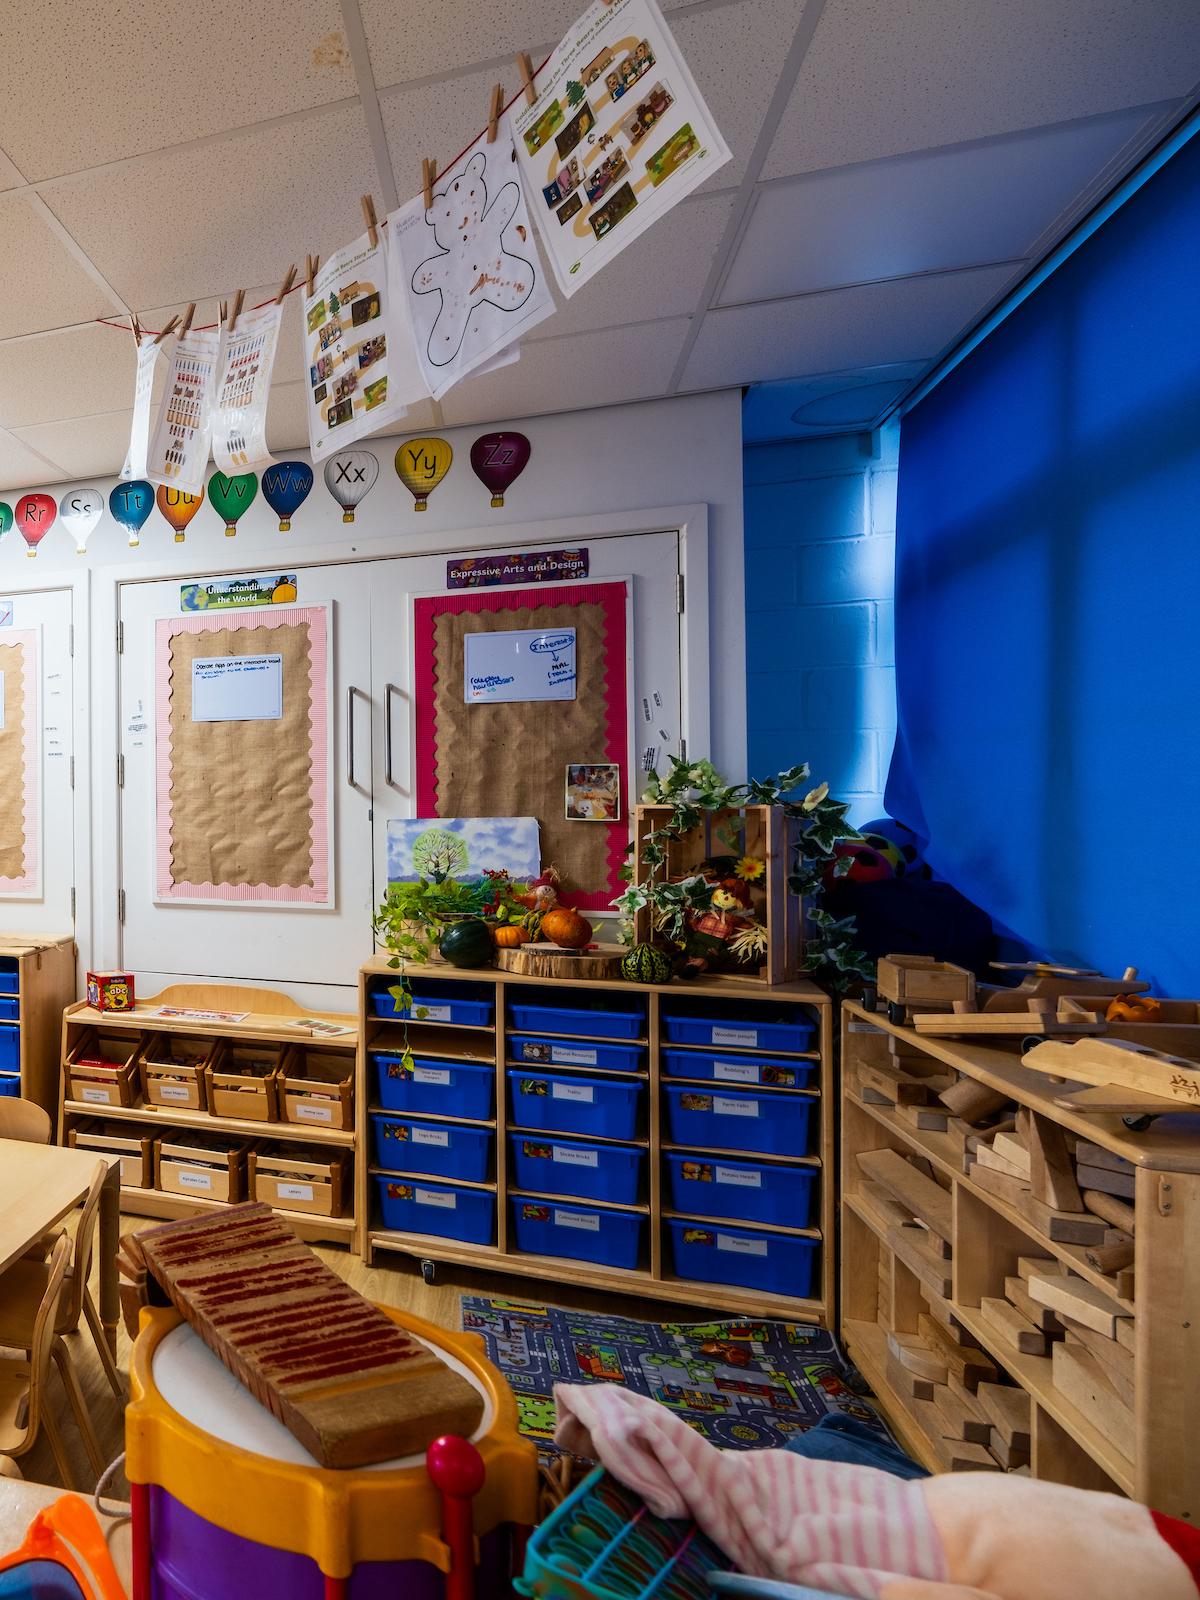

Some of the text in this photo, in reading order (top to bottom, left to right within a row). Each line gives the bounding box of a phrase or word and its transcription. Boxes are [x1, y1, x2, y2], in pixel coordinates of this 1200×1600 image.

[594, 8, 614, 27] Story
[408, 449, 437, 479] Yy
[483, 443, 513, 467] Zz
[335, 461, 366, 484] Xx
[218, 477, 246, 499] Vv
[264, 472, 311, 493] Ww
[71, 499, 91, 514] Ss
[120, 490, 142, 512] Tt
[25, 503, 46, 522] Rr
[450, 560, 584, 579] Expressive Arts and Design
[207, 582, 270, 595] Understanding
[233, 593, 258, 602] World
[109, 986, 127, 996] abc
